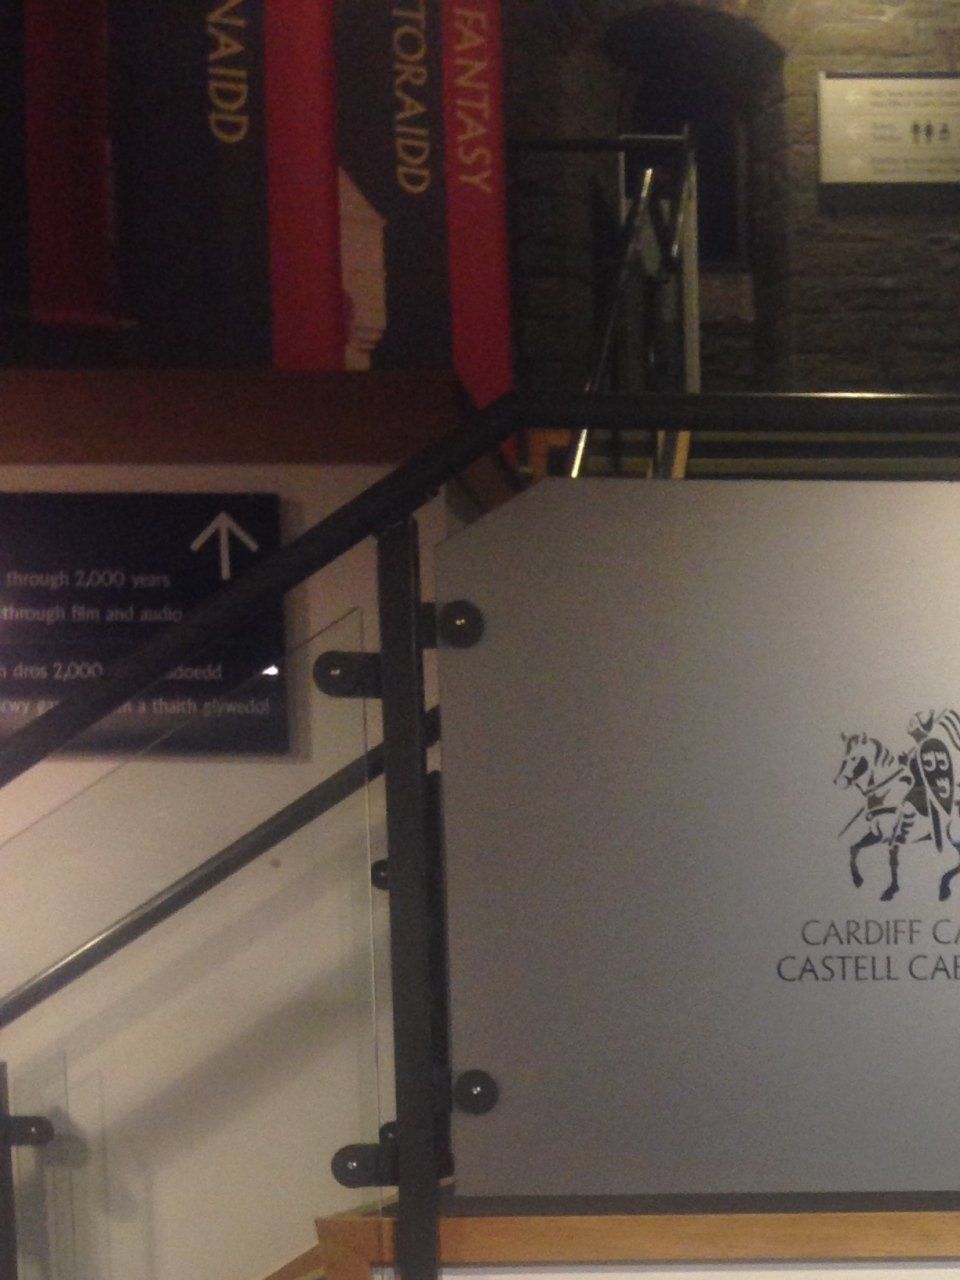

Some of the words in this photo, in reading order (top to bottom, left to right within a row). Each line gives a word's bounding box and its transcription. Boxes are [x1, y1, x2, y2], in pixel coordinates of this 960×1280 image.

[454, 7, 493, 193] FANTASY
[6, 570, 70, 588] through
[75, 570, 126, 587] 2,000
[131, 574, 171, 588] years
[1, 604, 66, 624] through
[72, 604, 100, 620] film
[106, 605, 134, 620] and
[140, 605, 183, 621] audio
[53, 662, 103, 681] 2,000
[800, 918, 922, 946] CARDIFF
[776, 955, 899, 982] CASTELL
